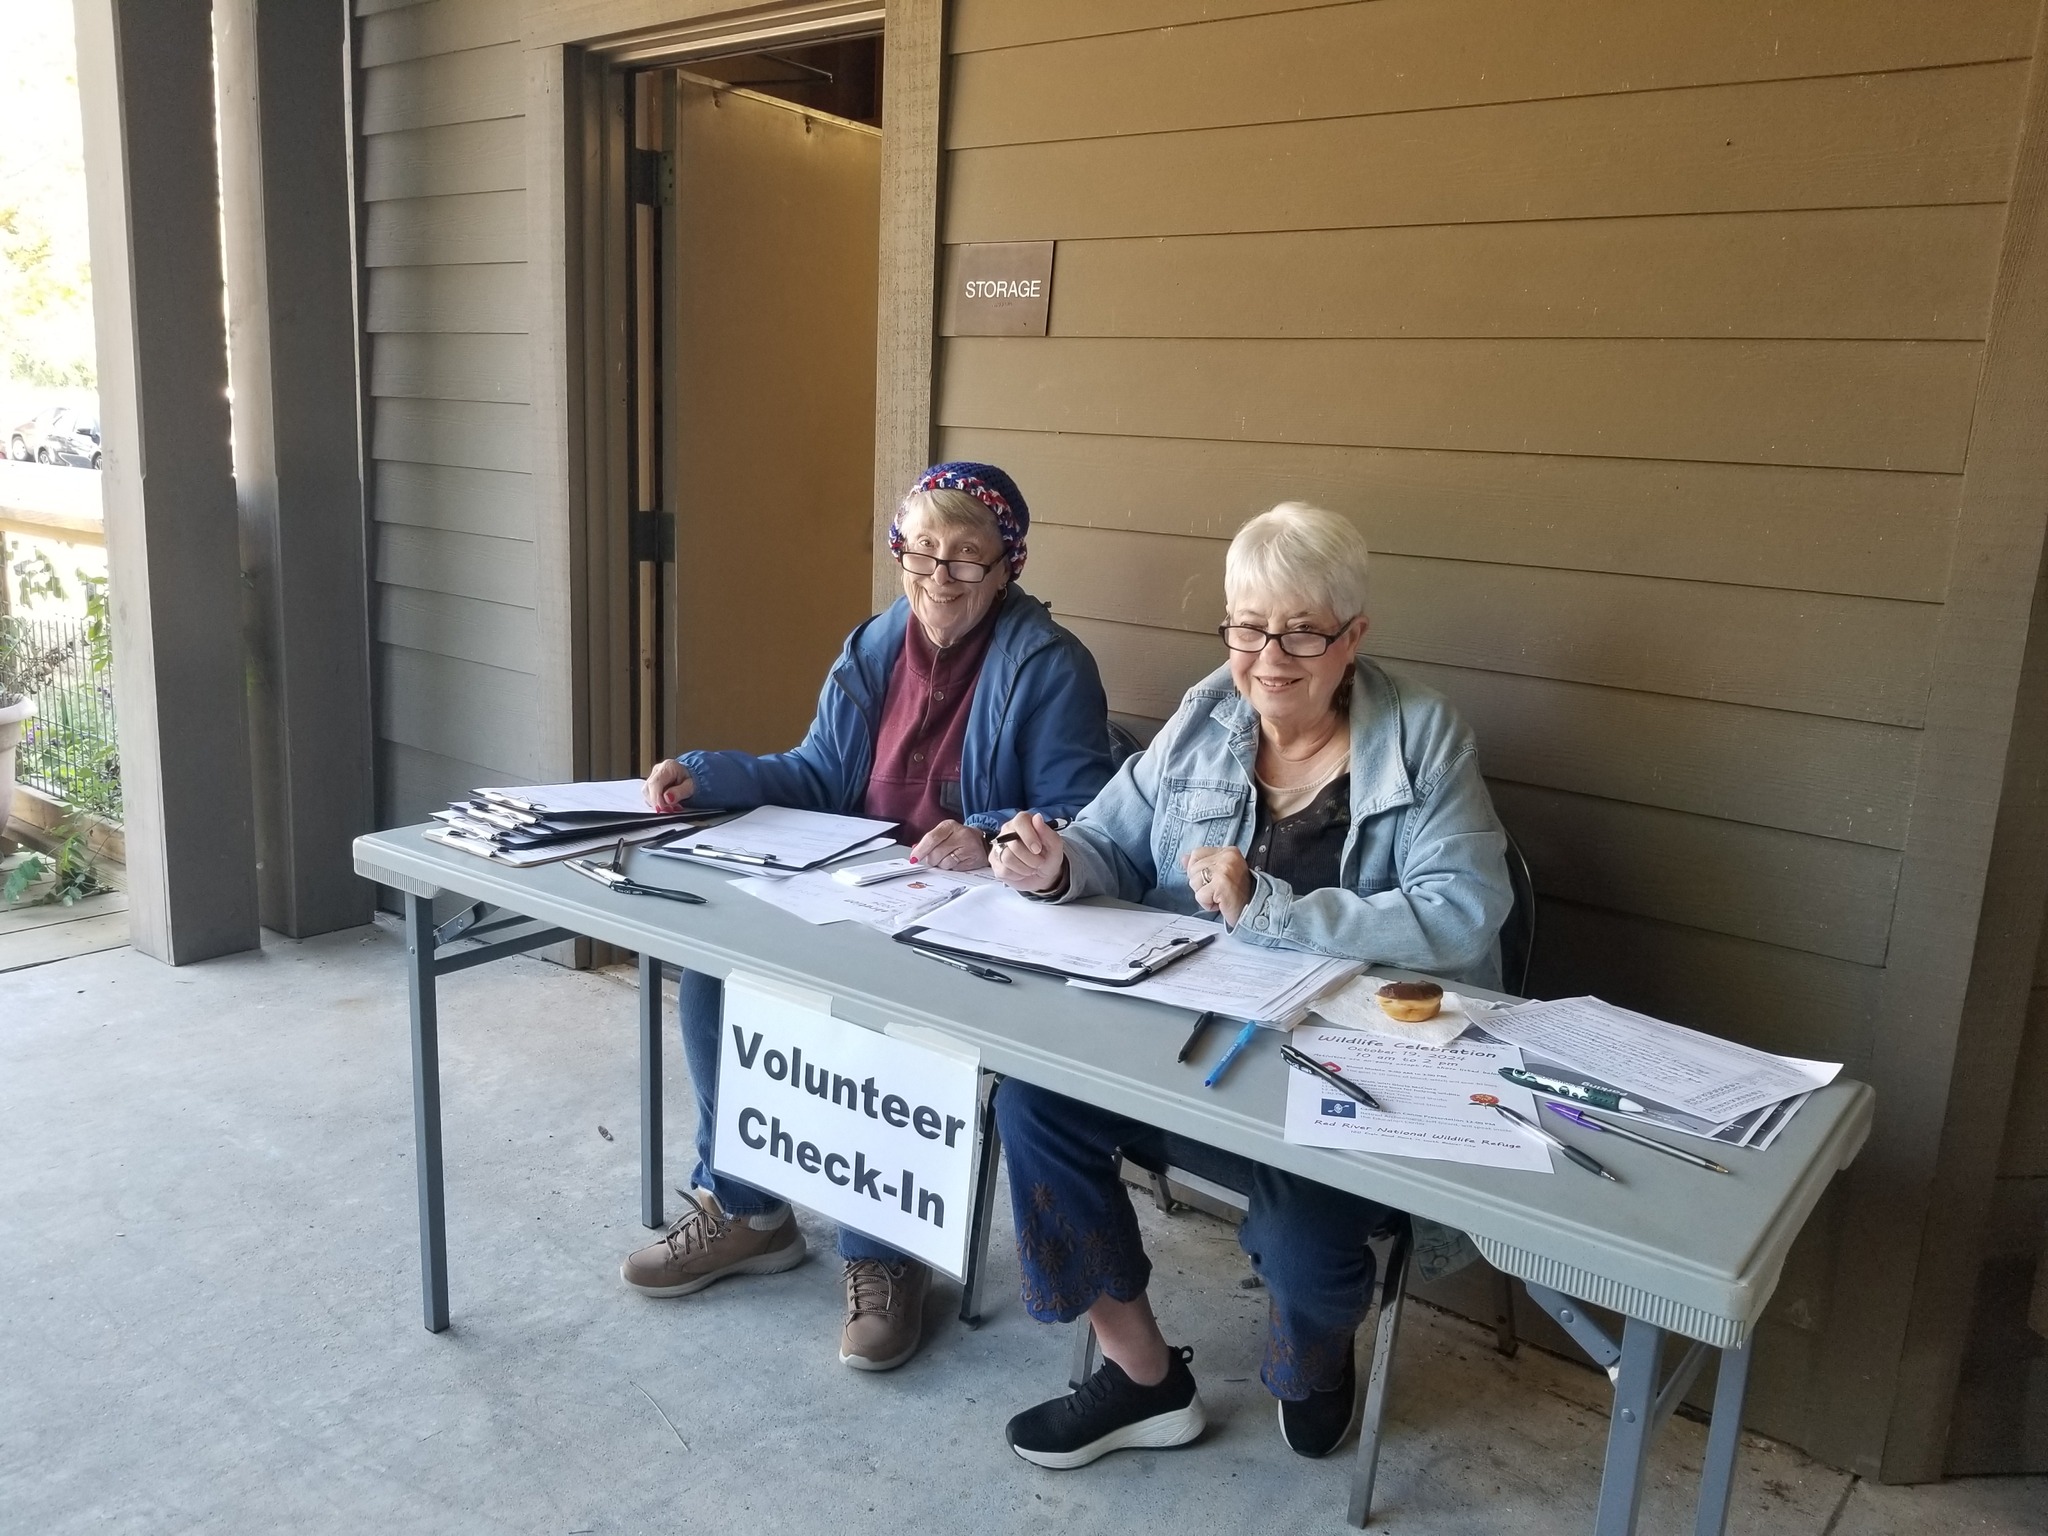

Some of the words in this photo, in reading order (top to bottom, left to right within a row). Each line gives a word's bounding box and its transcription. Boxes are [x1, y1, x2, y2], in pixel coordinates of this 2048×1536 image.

[965, 280, 1042, 298] STORAGE
[1318, 1034, 1384, 1047] Wildlife
[1394, 1042, 1497, 1059] Celebration
[1348, 1046, 1398, 1056] October
[1428, 1053, 1466, 1062] 2024
[732, 1024, 966, 1148] Volunteer
[1580, 1081, 1628, 1097] Parking
[1314, 1119, 1336, 1127] Red
[1342, 1122, 1372, 1131] River
[1377, 1127, 1427, 1138] National
[1432, 1133, 1476, 1144] Wildlife
[1481, 1139, 1522, 1149] Refuge
[738, 1107, 945, 1229] Check-In
